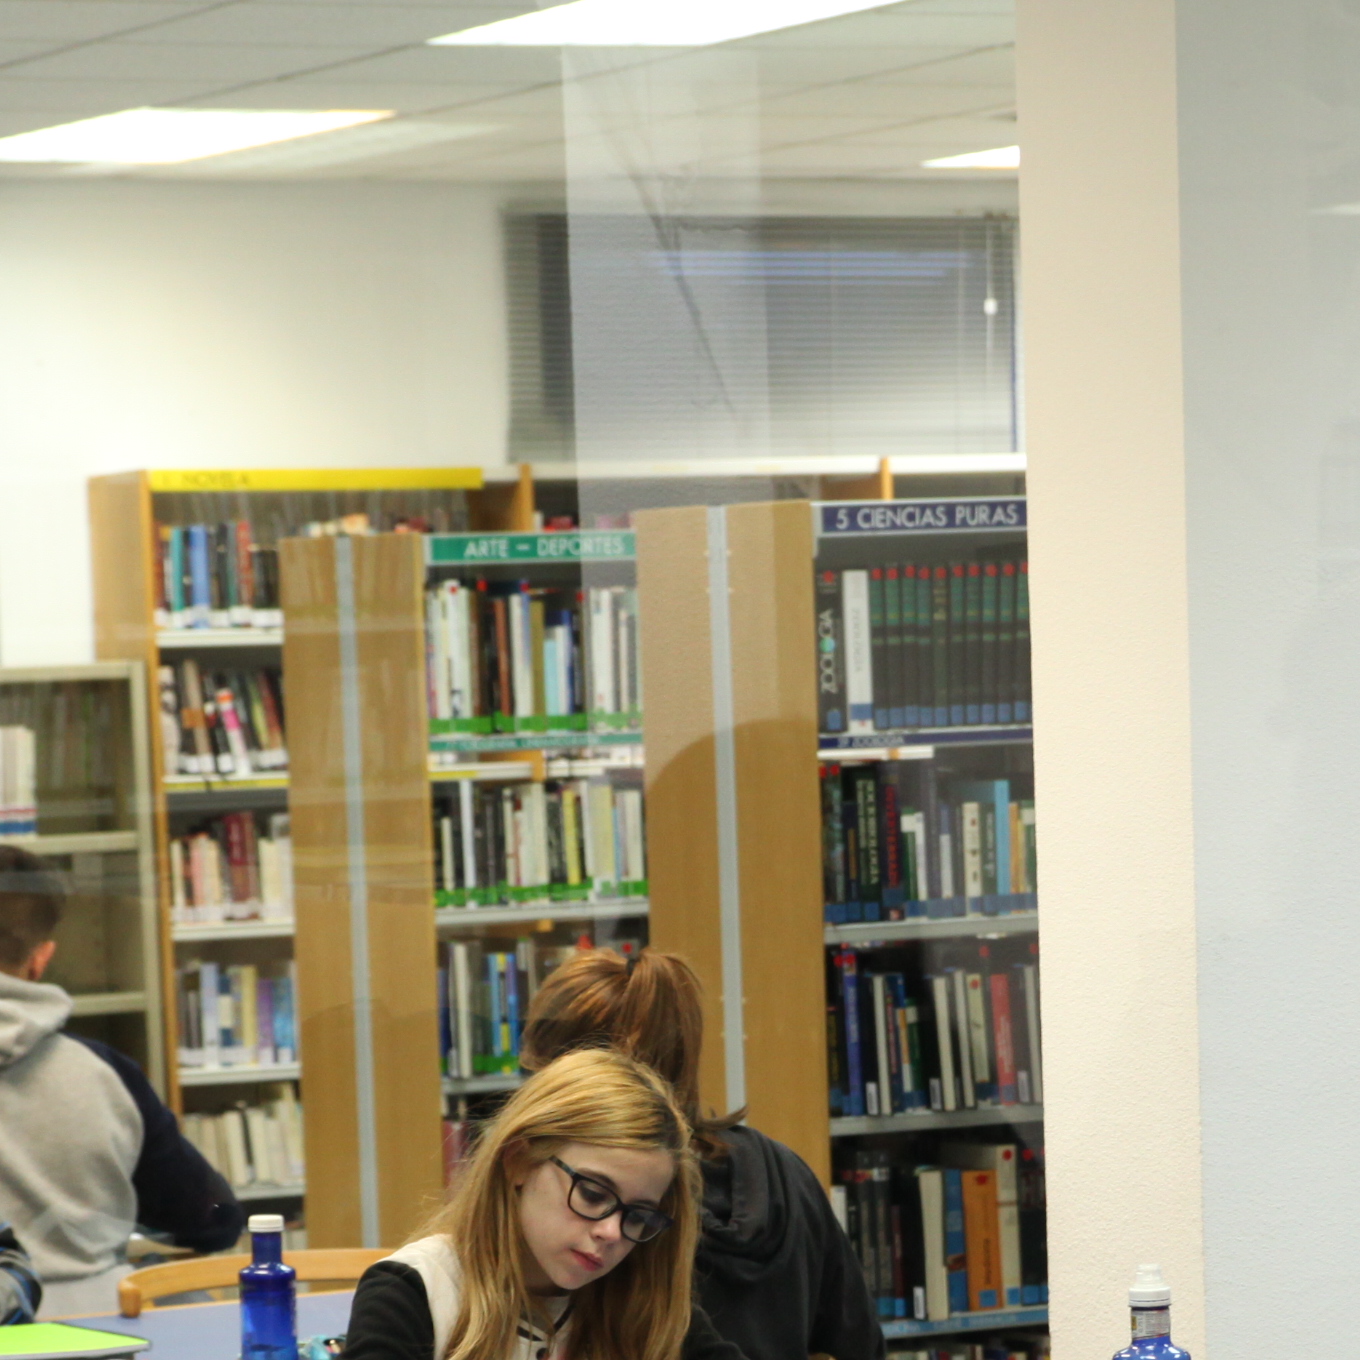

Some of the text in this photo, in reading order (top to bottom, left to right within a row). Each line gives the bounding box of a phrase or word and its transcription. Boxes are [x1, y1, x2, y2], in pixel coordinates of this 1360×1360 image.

[835, 503, 1019, 530] 5 CIENCIAS PURAS
[463, 538, 509, 558] ARTE
[536, 535, 626, 556] DEPORTES
